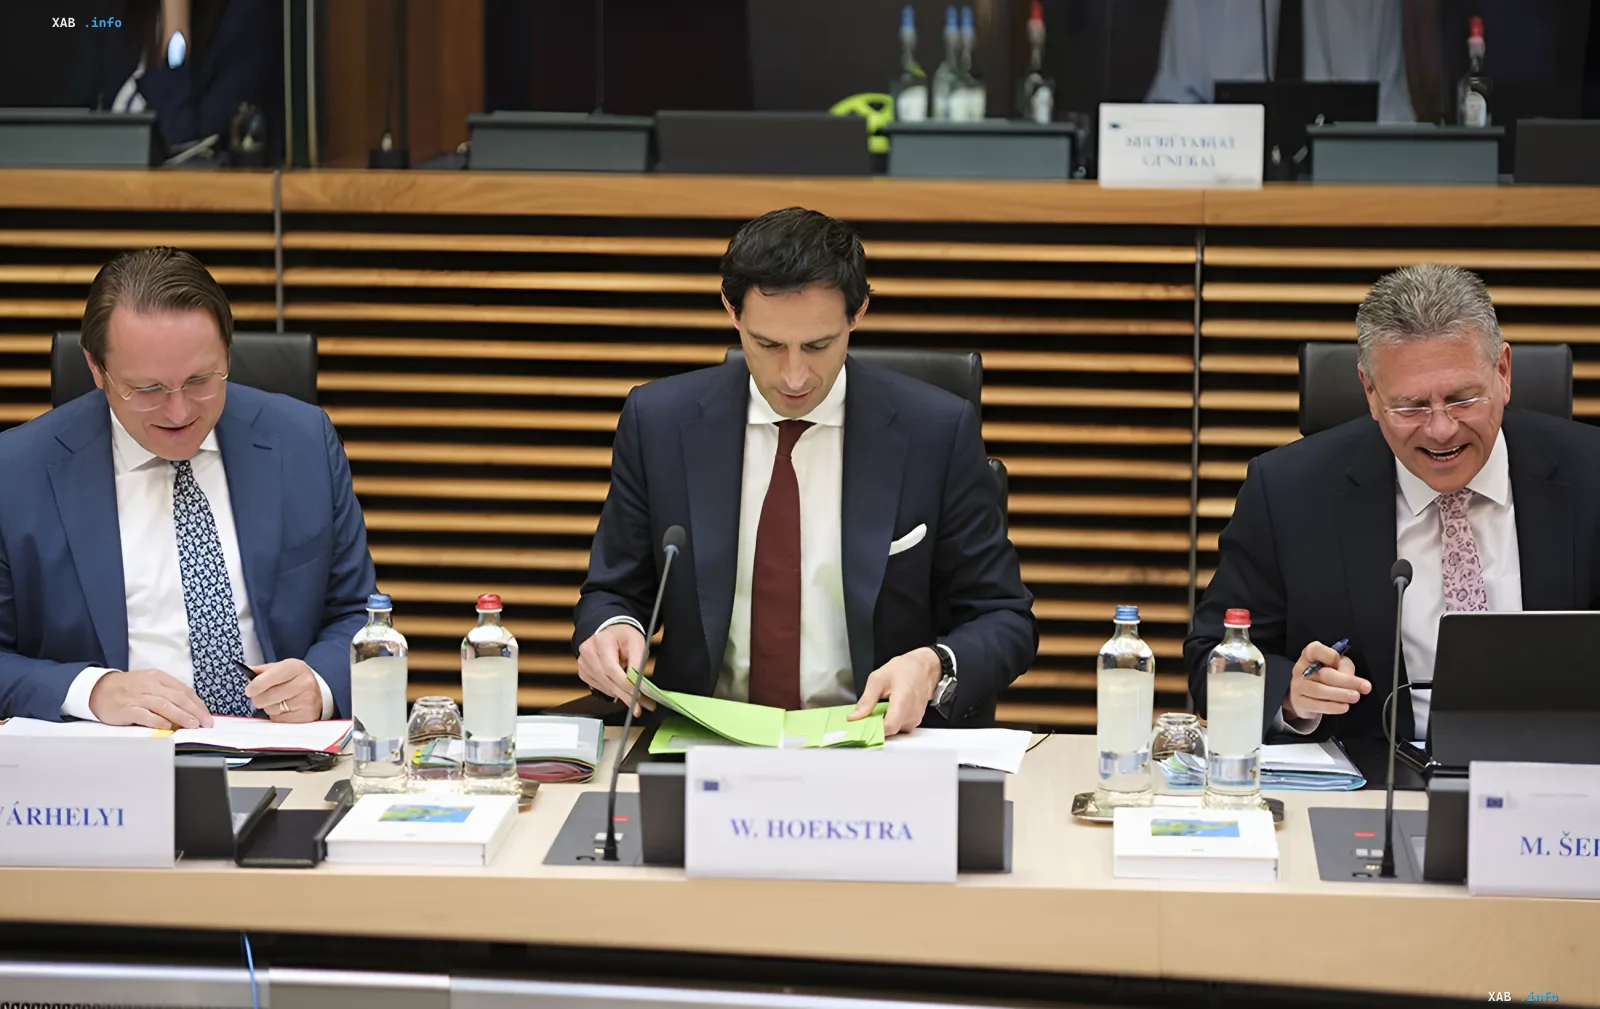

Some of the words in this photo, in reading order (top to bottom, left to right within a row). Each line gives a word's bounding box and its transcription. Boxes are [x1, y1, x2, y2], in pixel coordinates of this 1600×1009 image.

[0, 800, 124, 827] ÁRHELYI
[730, 818, 758, 838] W.
[767, 819, 914, 841] HOEKSTRA
[1520, 835, 1551, 856] M.
